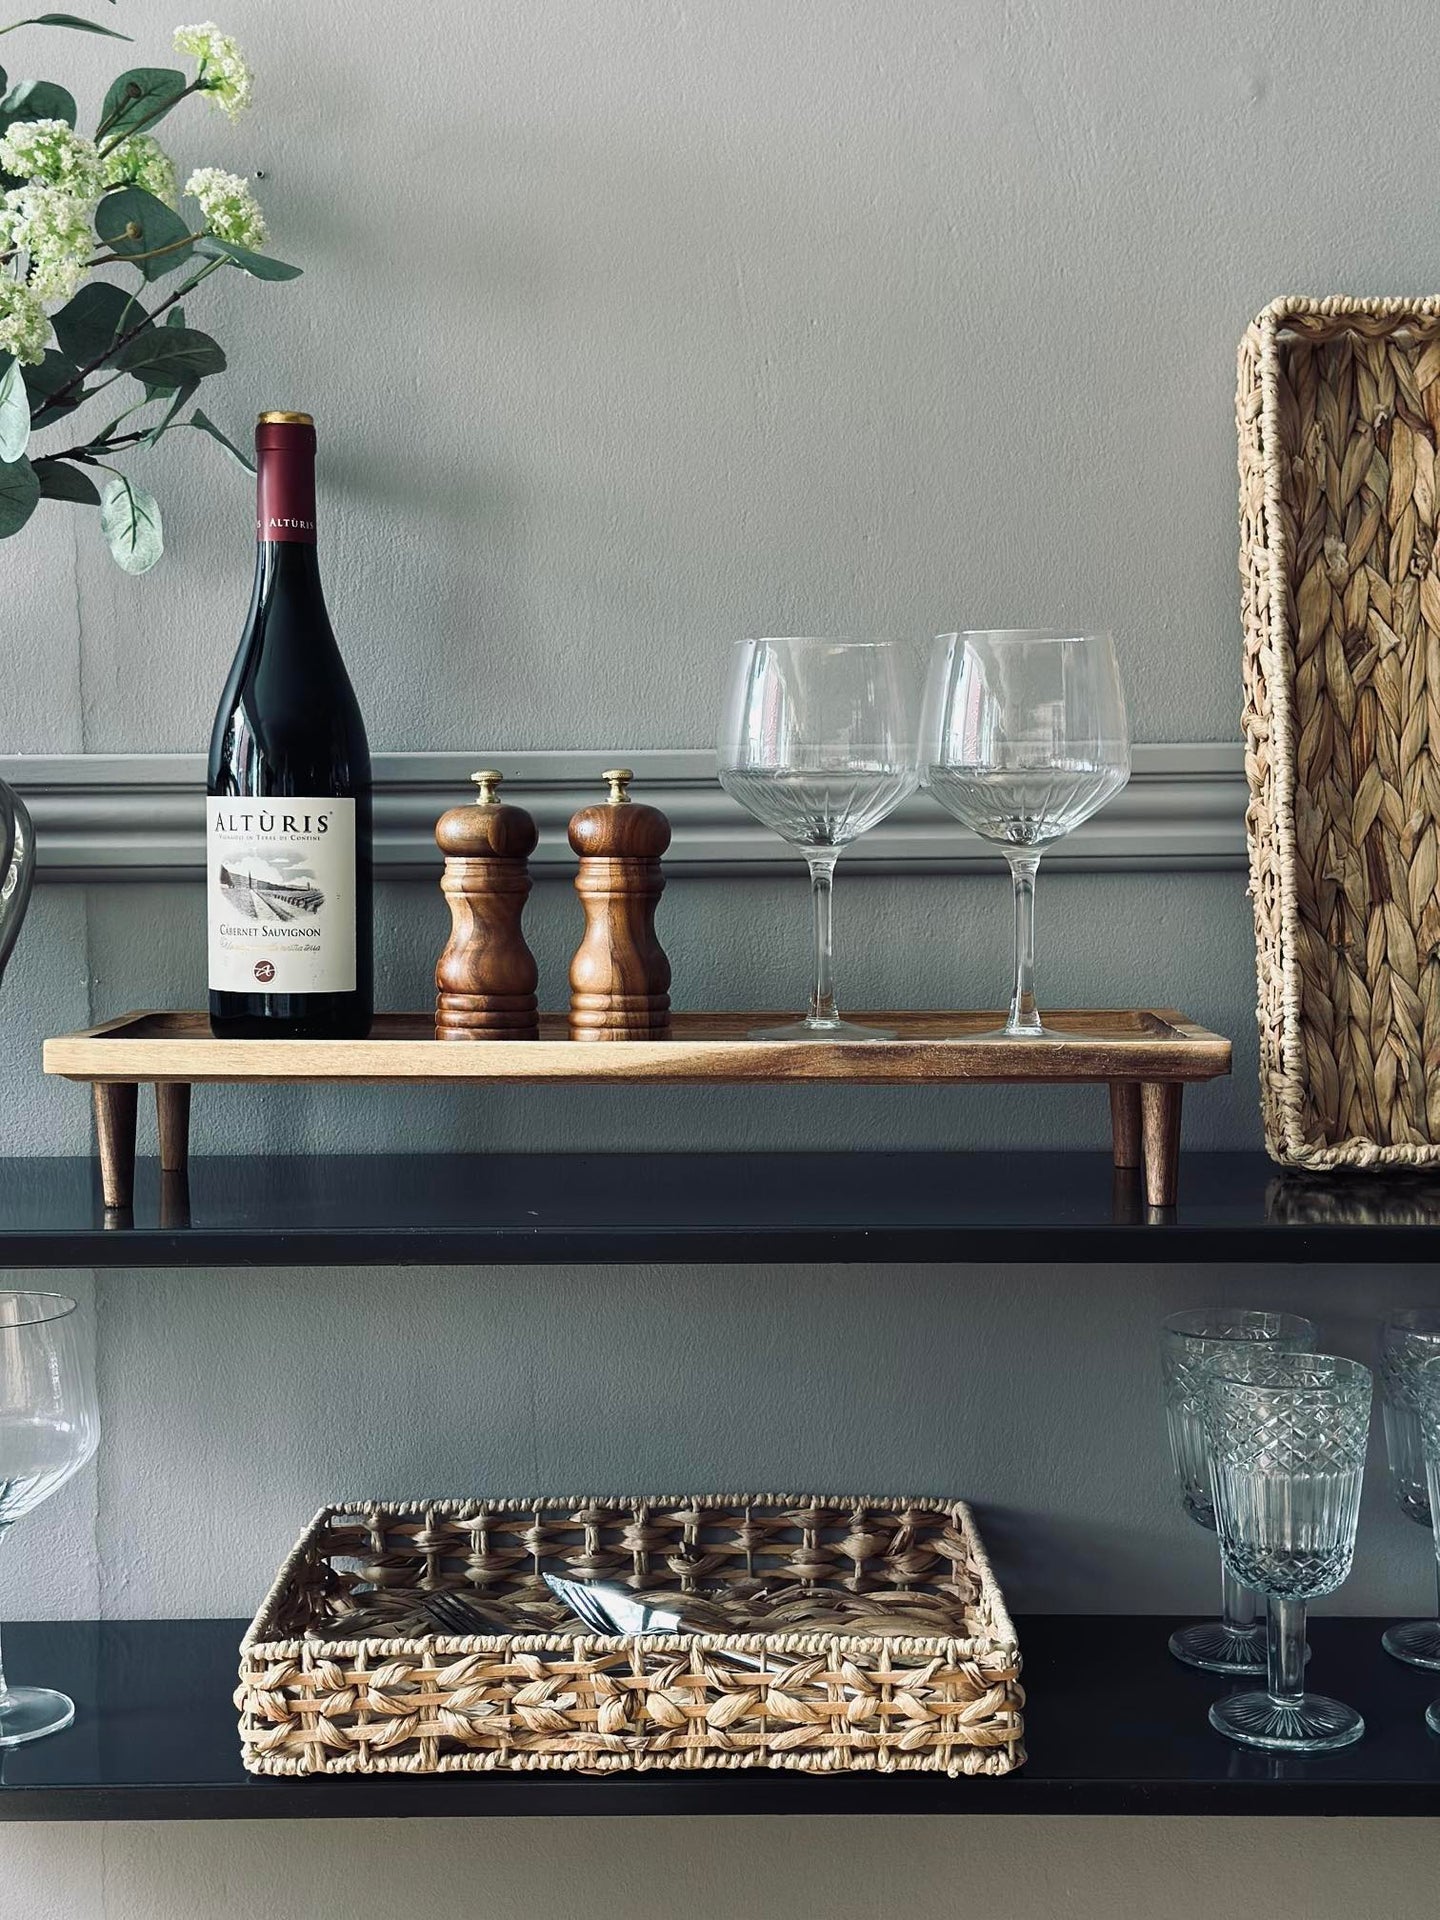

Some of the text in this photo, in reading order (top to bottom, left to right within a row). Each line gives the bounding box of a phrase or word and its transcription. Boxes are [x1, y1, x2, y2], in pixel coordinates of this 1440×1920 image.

[269, 517, 314, 530] ALTÙRIS
[214, 809, 329, 834] ALTÙRIS
[219, 923, 321, 938] CABERNET SAUVIGNON
